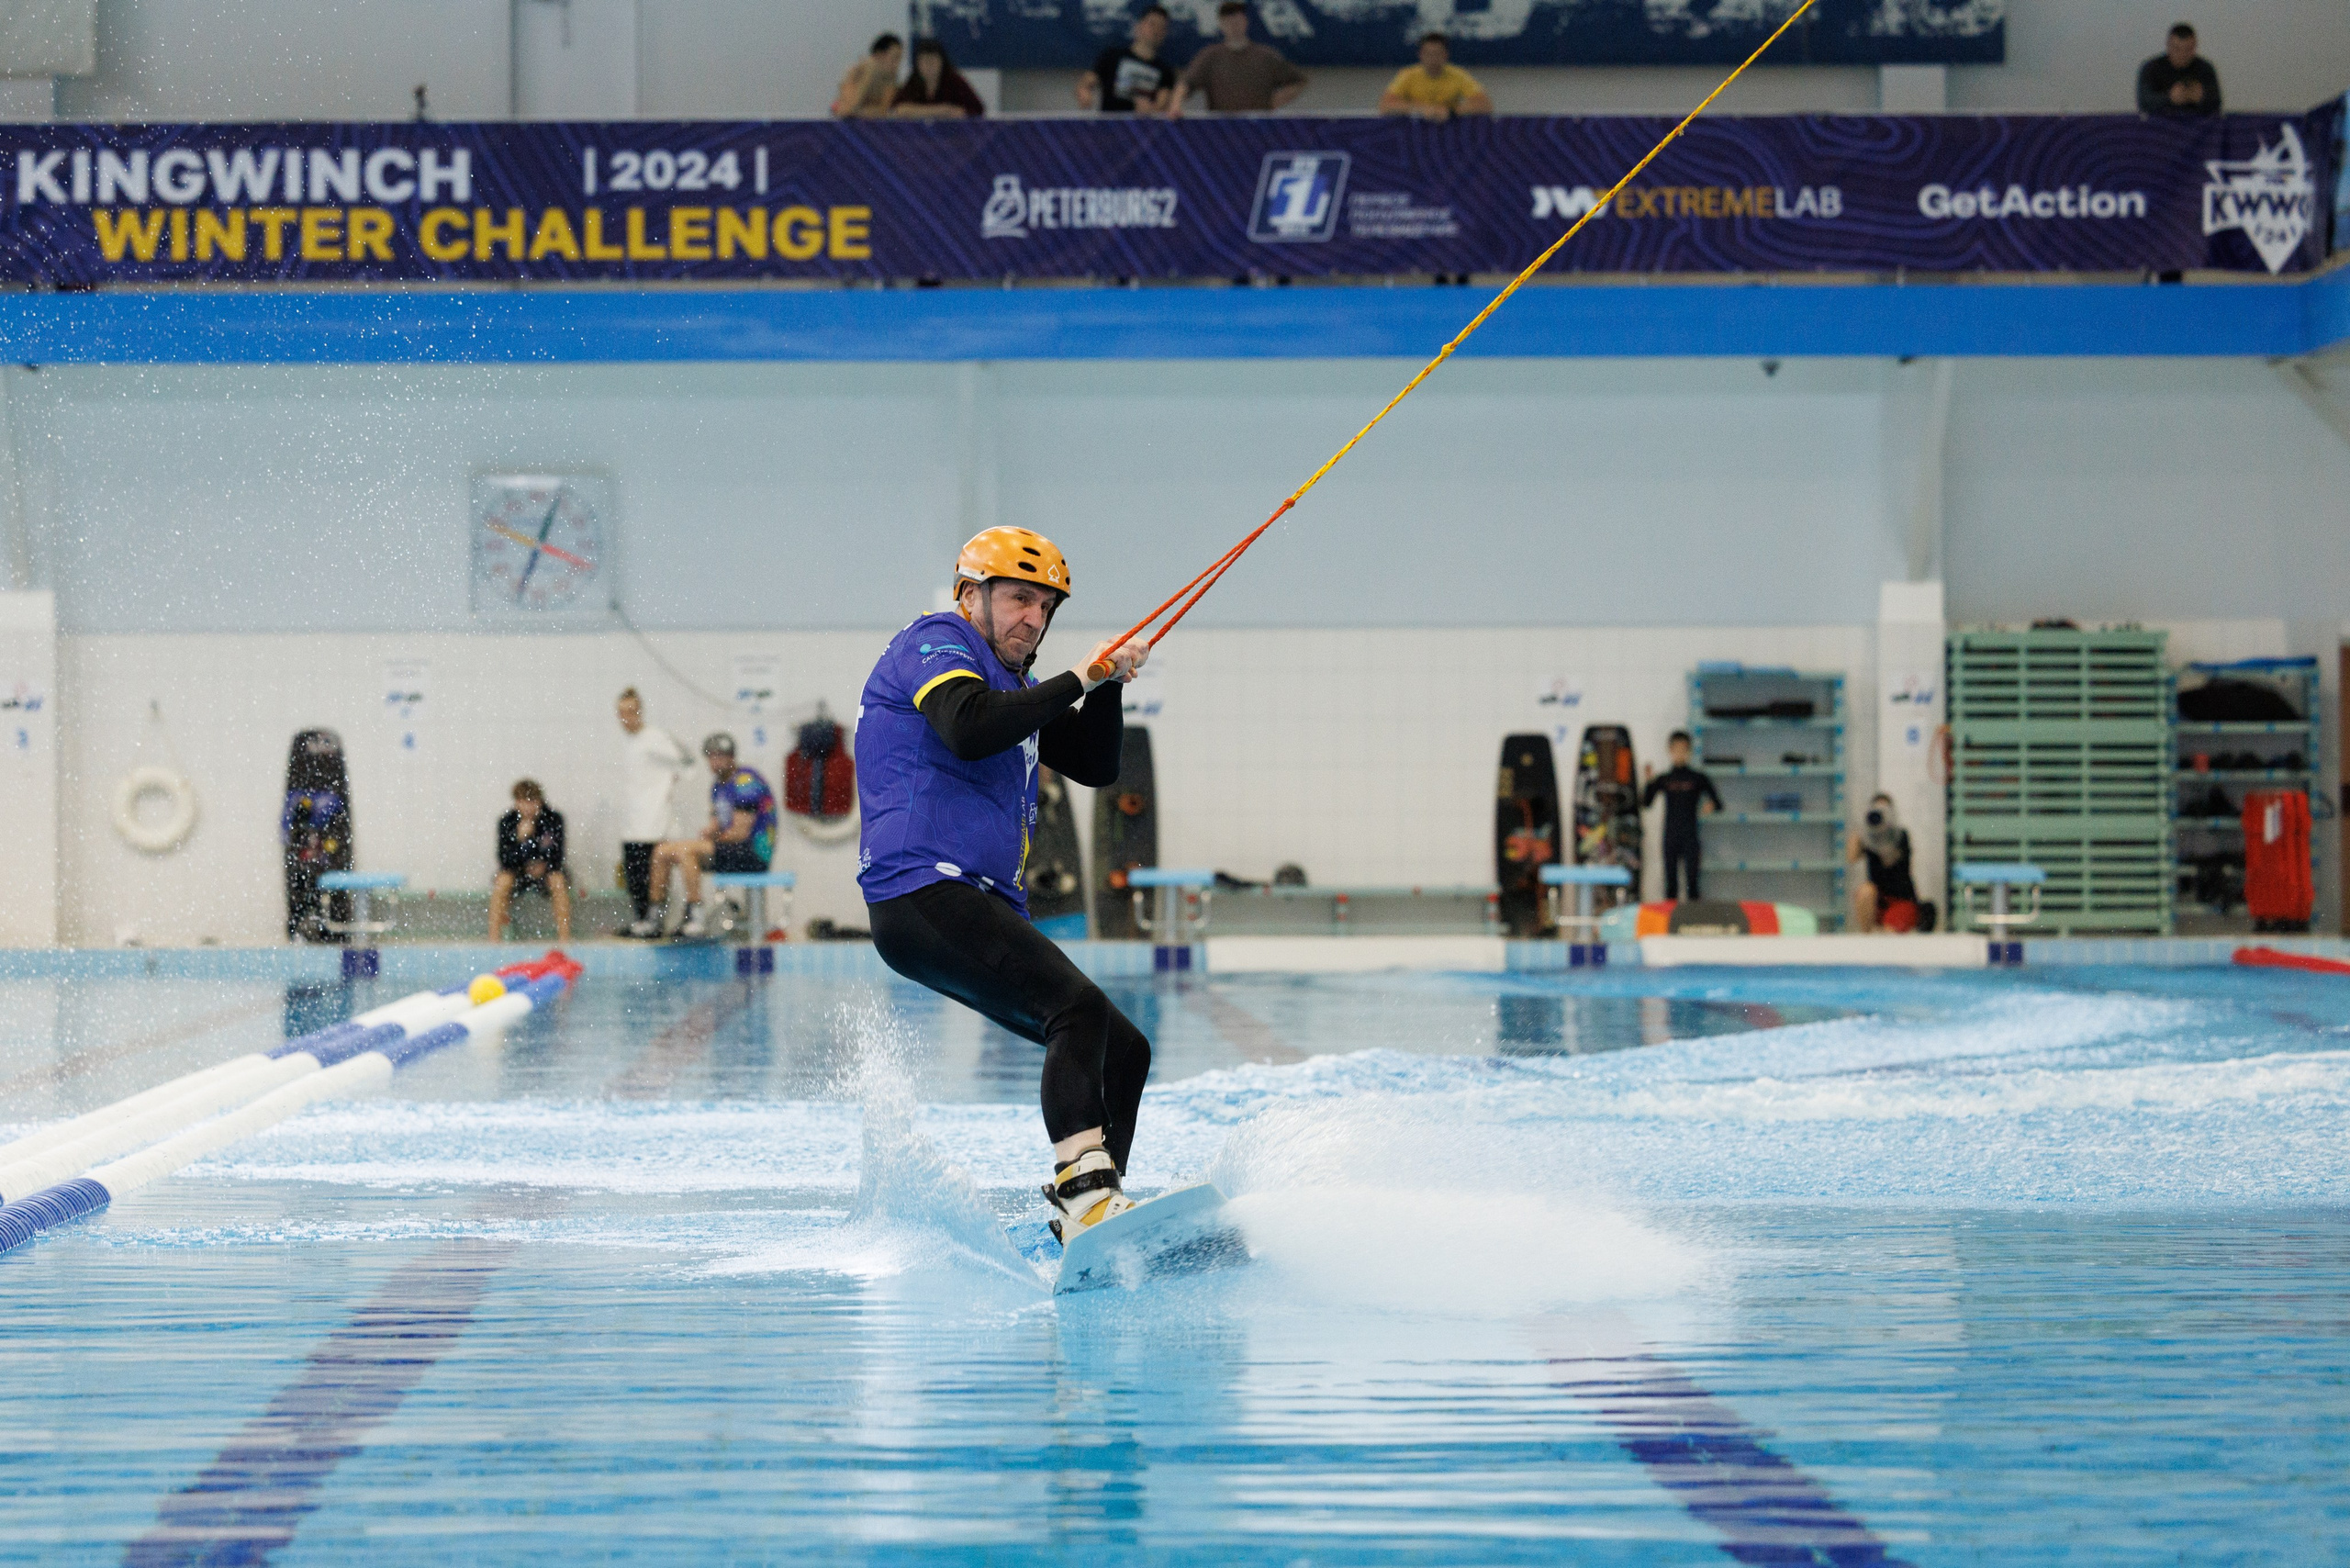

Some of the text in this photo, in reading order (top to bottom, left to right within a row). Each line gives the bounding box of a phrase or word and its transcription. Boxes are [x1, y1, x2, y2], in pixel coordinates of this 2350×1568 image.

[17, 148, 471, 205] KINGWINCH
[610, 150, 742, 191] 2024
[1615, 185, 1843, 219] EXTREMELAB
[1917, 184, 2147, 219] GetAction
[92, 205, 872, 263] WINTER CHALLENGE
